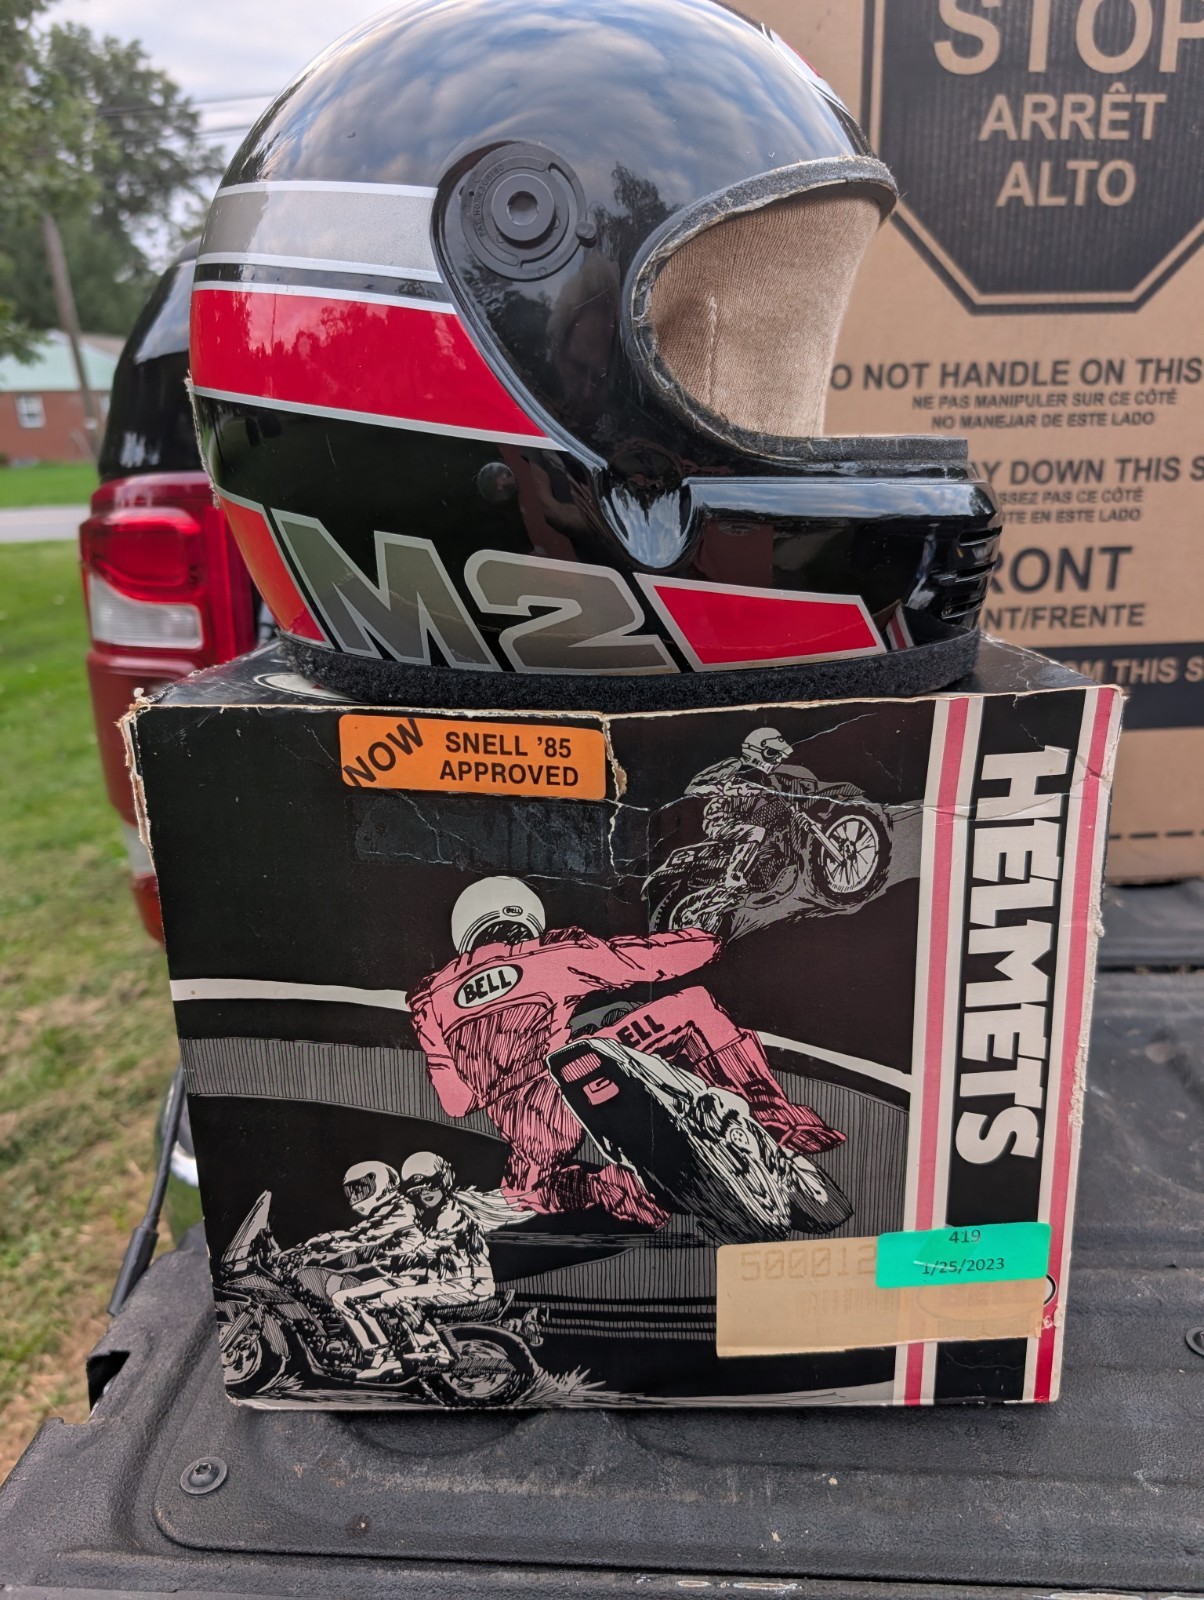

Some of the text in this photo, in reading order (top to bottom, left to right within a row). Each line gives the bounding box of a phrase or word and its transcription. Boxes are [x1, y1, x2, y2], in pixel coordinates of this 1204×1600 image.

[978, 82, 1167, 142] ARRÊT
[996, 159, 1136, 207] ALTO
[830, 357, 1203, 391] O NOT HANDLE ON THIS
[911, 387, 1178, 410] NE PAS MANIPULER SUR CE CÔTÉ
[931, 411, 1155, 430] NO MANEJAR DE ESTE LADO
[1009, 458, 1105, 485] DOWN
[1115, 456, 1181, 483] THIS
[998, 485, 1145, 505] SSEZ PAS CE CÔTÉ
[1031, 509, 1051, 524] EN
[1055, 508, 1096, 524] ESTE
[1099, 508, 1142, 522] LADO
[271, 508, 681, 674] M2
[984, 603, 1146, 630] NT/FRENTE
[1111, 656, 1178, 684] THIS
[342, 718, 423, 787] NOW
[445, 731, 572, 759] SNELL '85
[439, 760, 579, 787] APPROVED
[955, 745, 1070, 1165] HELMETS
[463, 969, 513, 1004] BELL
[615, 1014, 666, 1050] ELL
[948, 1229, 981, 1244] 419
[921, 1257, 1006, 1277] 1/25/2023
